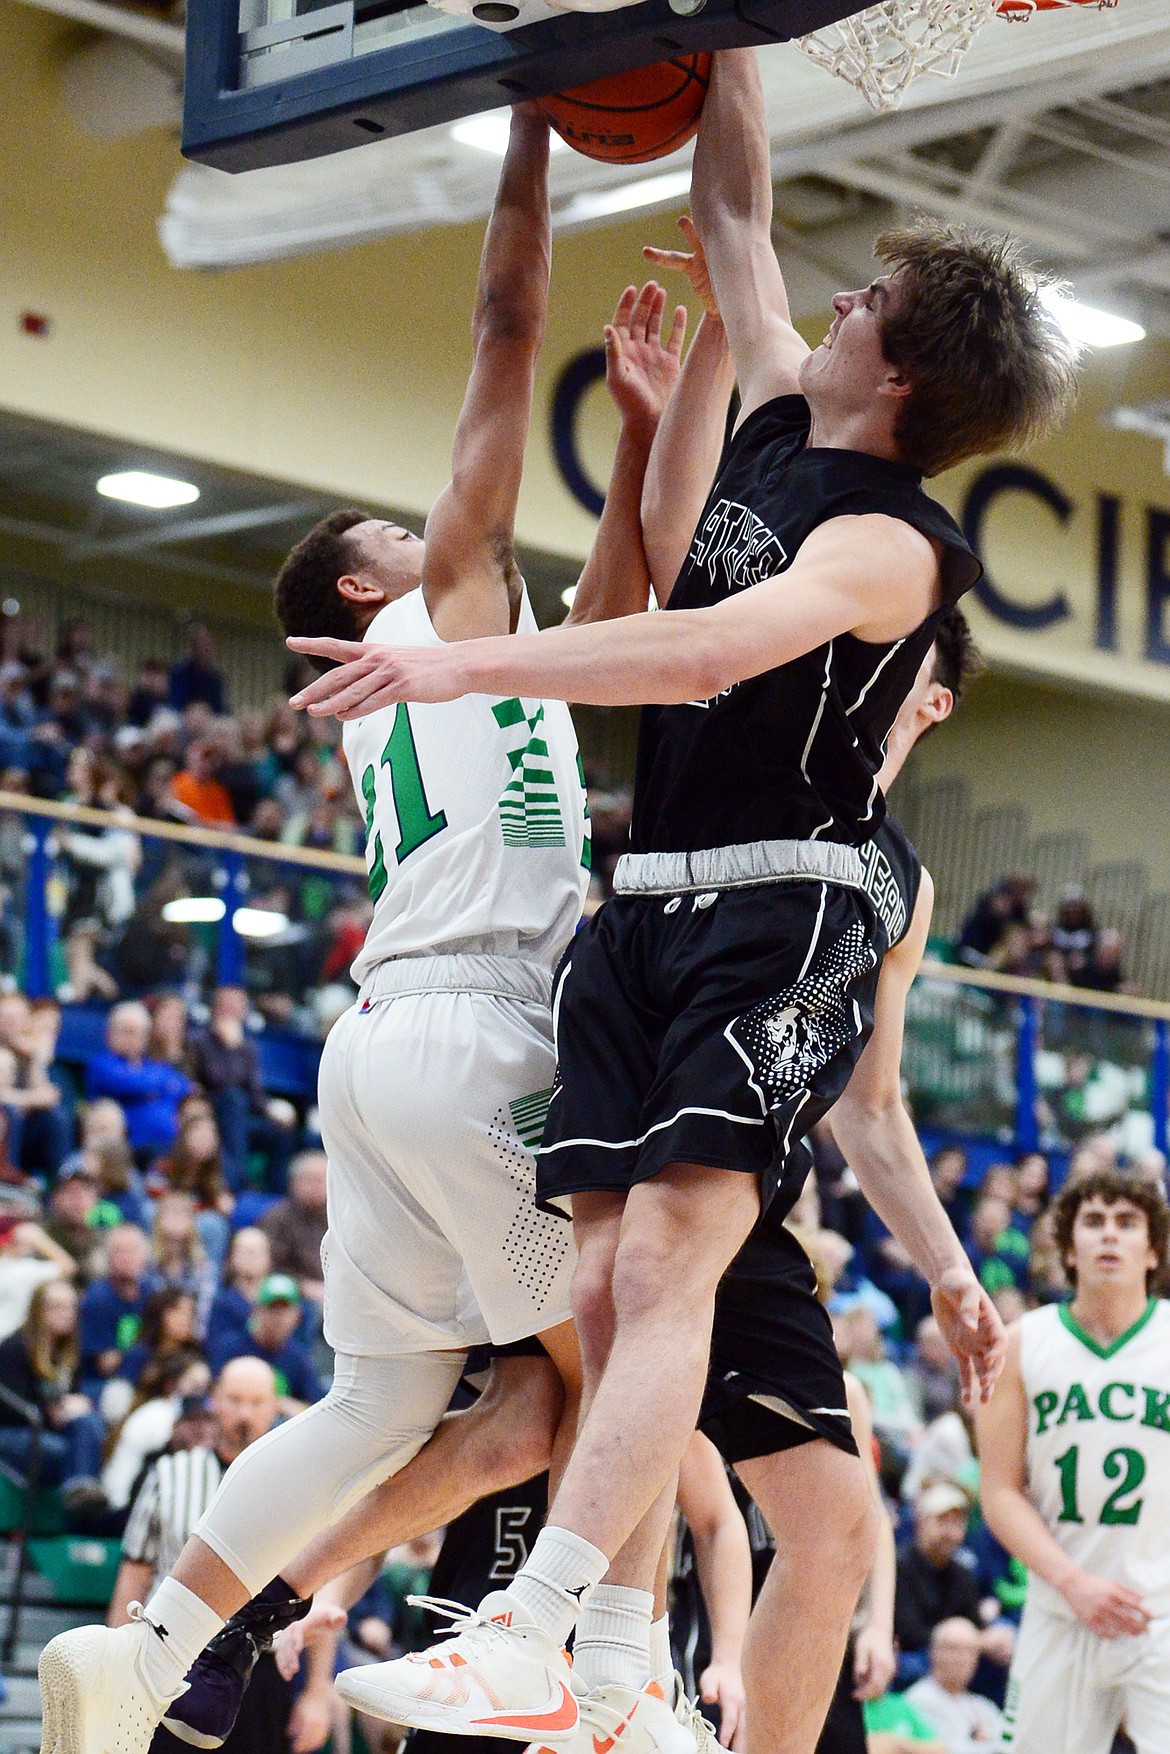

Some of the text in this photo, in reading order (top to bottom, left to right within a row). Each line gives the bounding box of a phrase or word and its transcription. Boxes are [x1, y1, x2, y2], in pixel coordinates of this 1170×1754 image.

[1033, 1382, 1170, 1434] PACK
[1054, 1445, 1146, 1525] 12
[488, 1506, 532, 1579] 5
